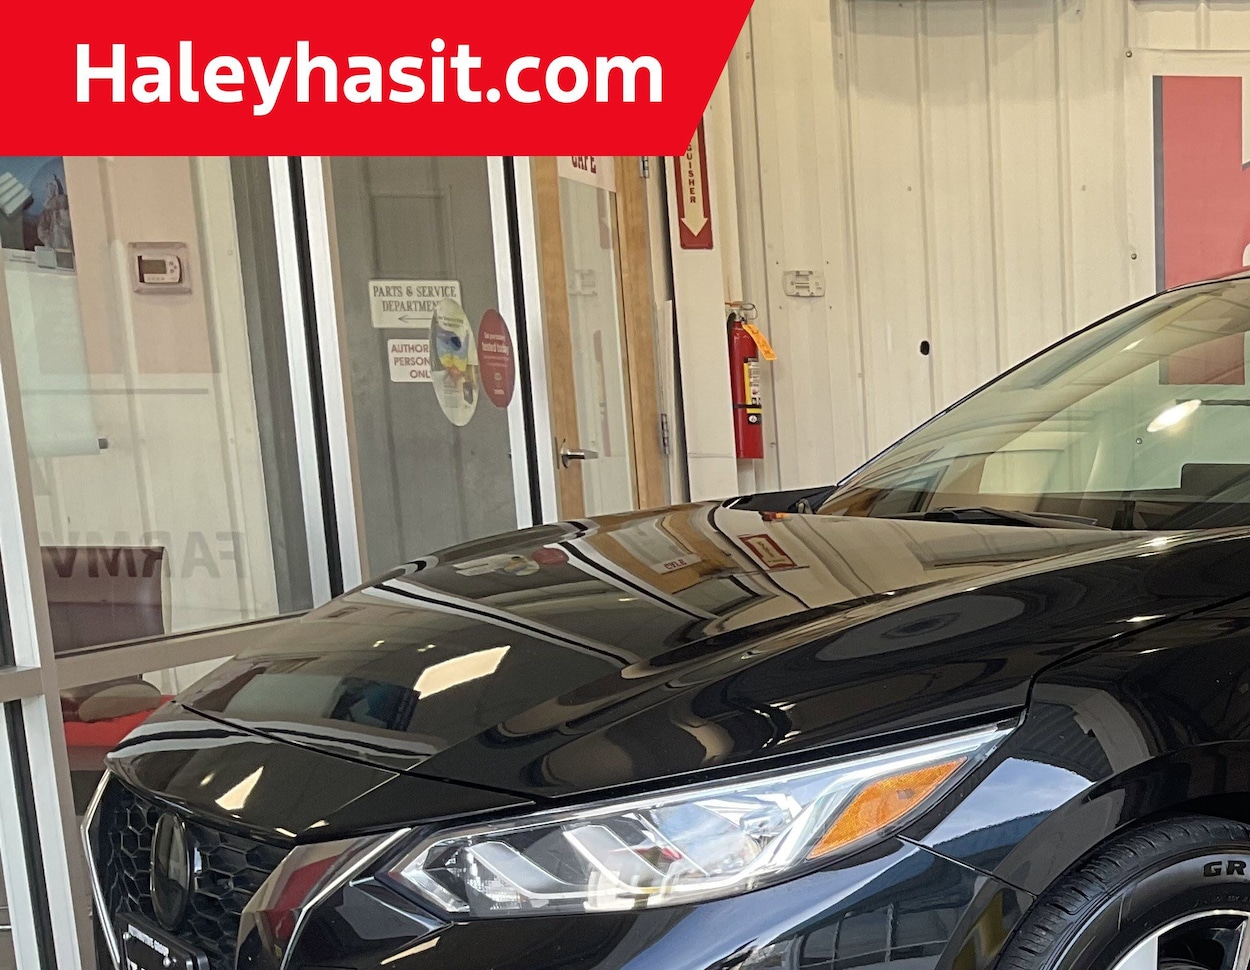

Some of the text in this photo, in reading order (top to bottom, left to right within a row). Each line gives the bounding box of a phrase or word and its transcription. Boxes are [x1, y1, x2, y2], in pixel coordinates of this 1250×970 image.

[373, 285, 457, 298] PARTS & SERVICE
